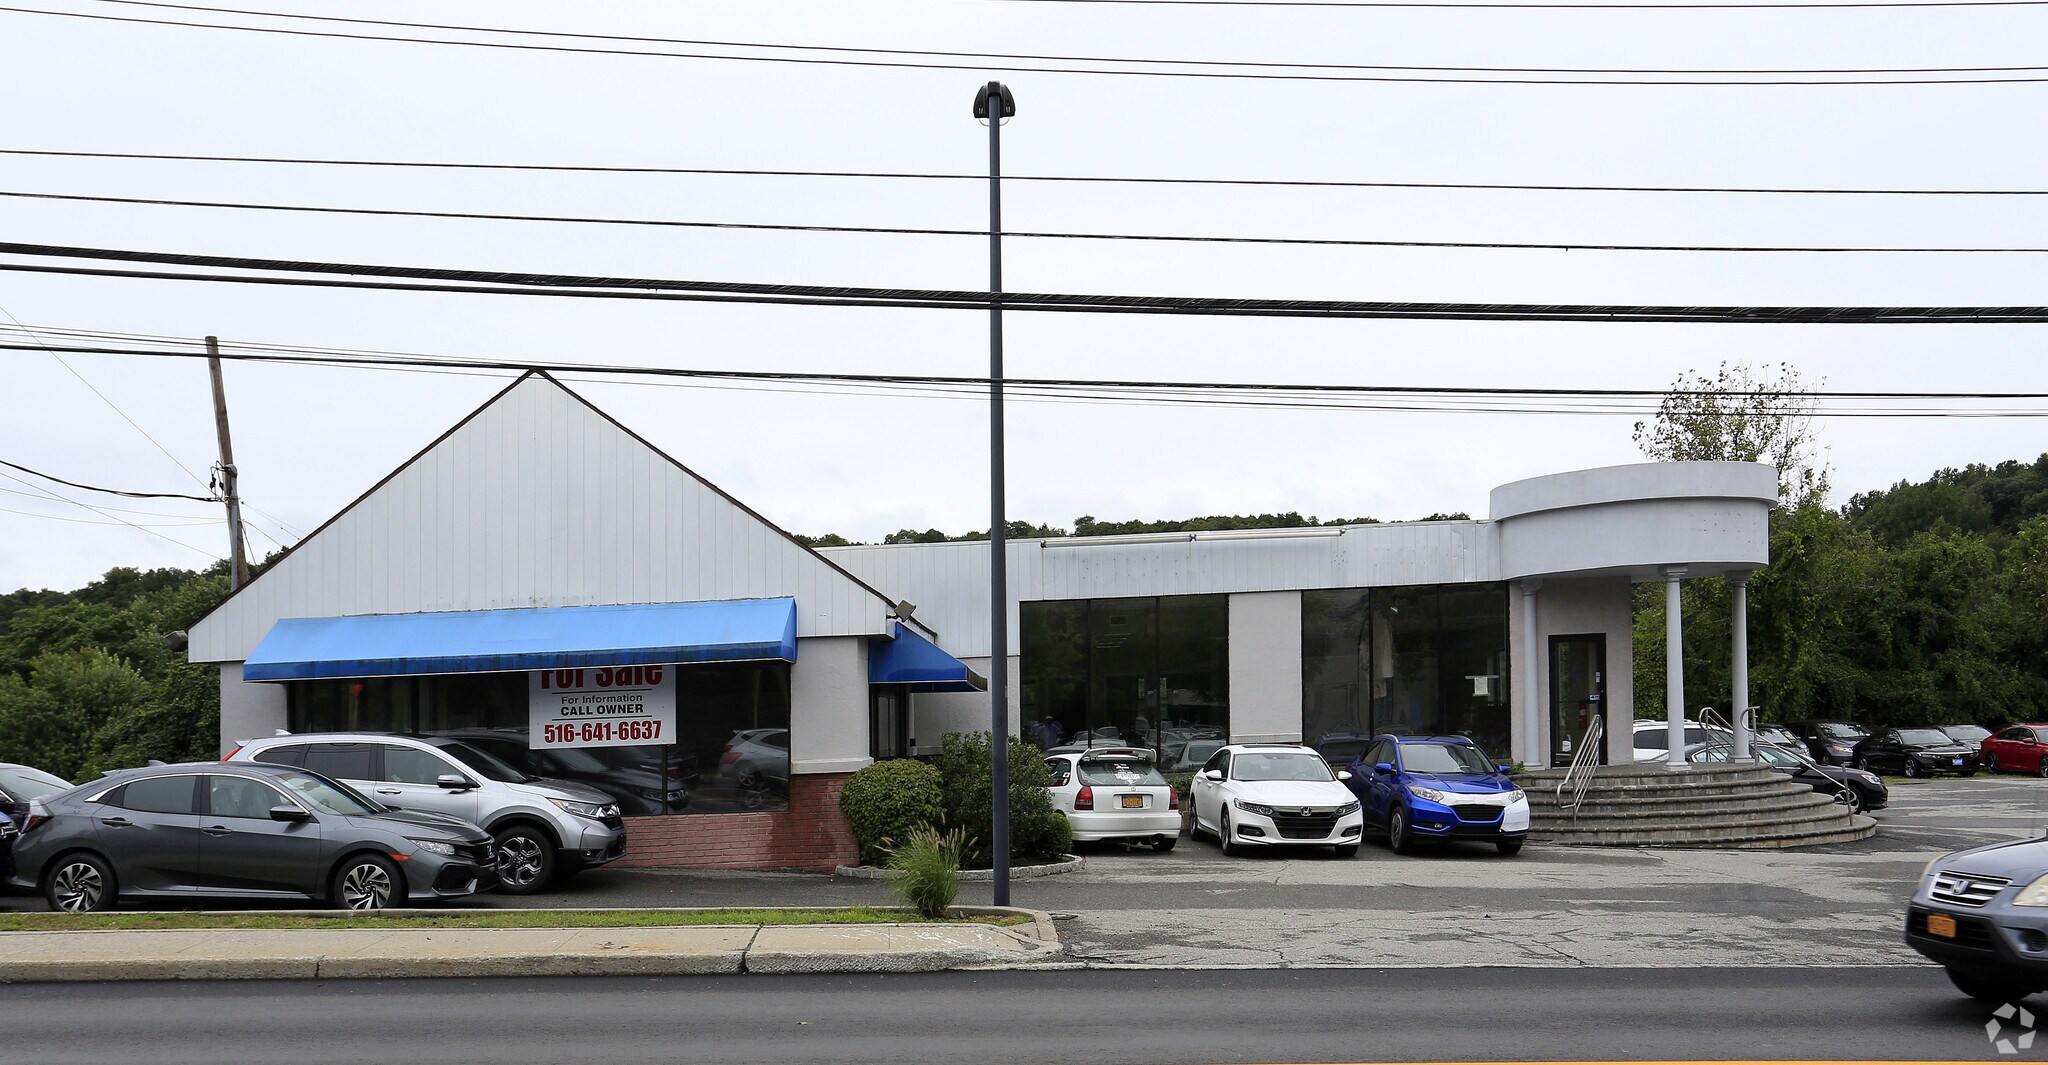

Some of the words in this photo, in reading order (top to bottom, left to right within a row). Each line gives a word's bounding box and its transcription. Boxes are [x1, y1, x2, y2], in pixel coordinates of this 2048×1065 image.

[561, 696, 579, 705] For
[582, 693, 643, 704] Information
[560, 705, 593, 716] CALL
[596, 703, 644, 715] OWNER
[544, 720, 662, 744] 516-641-6637
